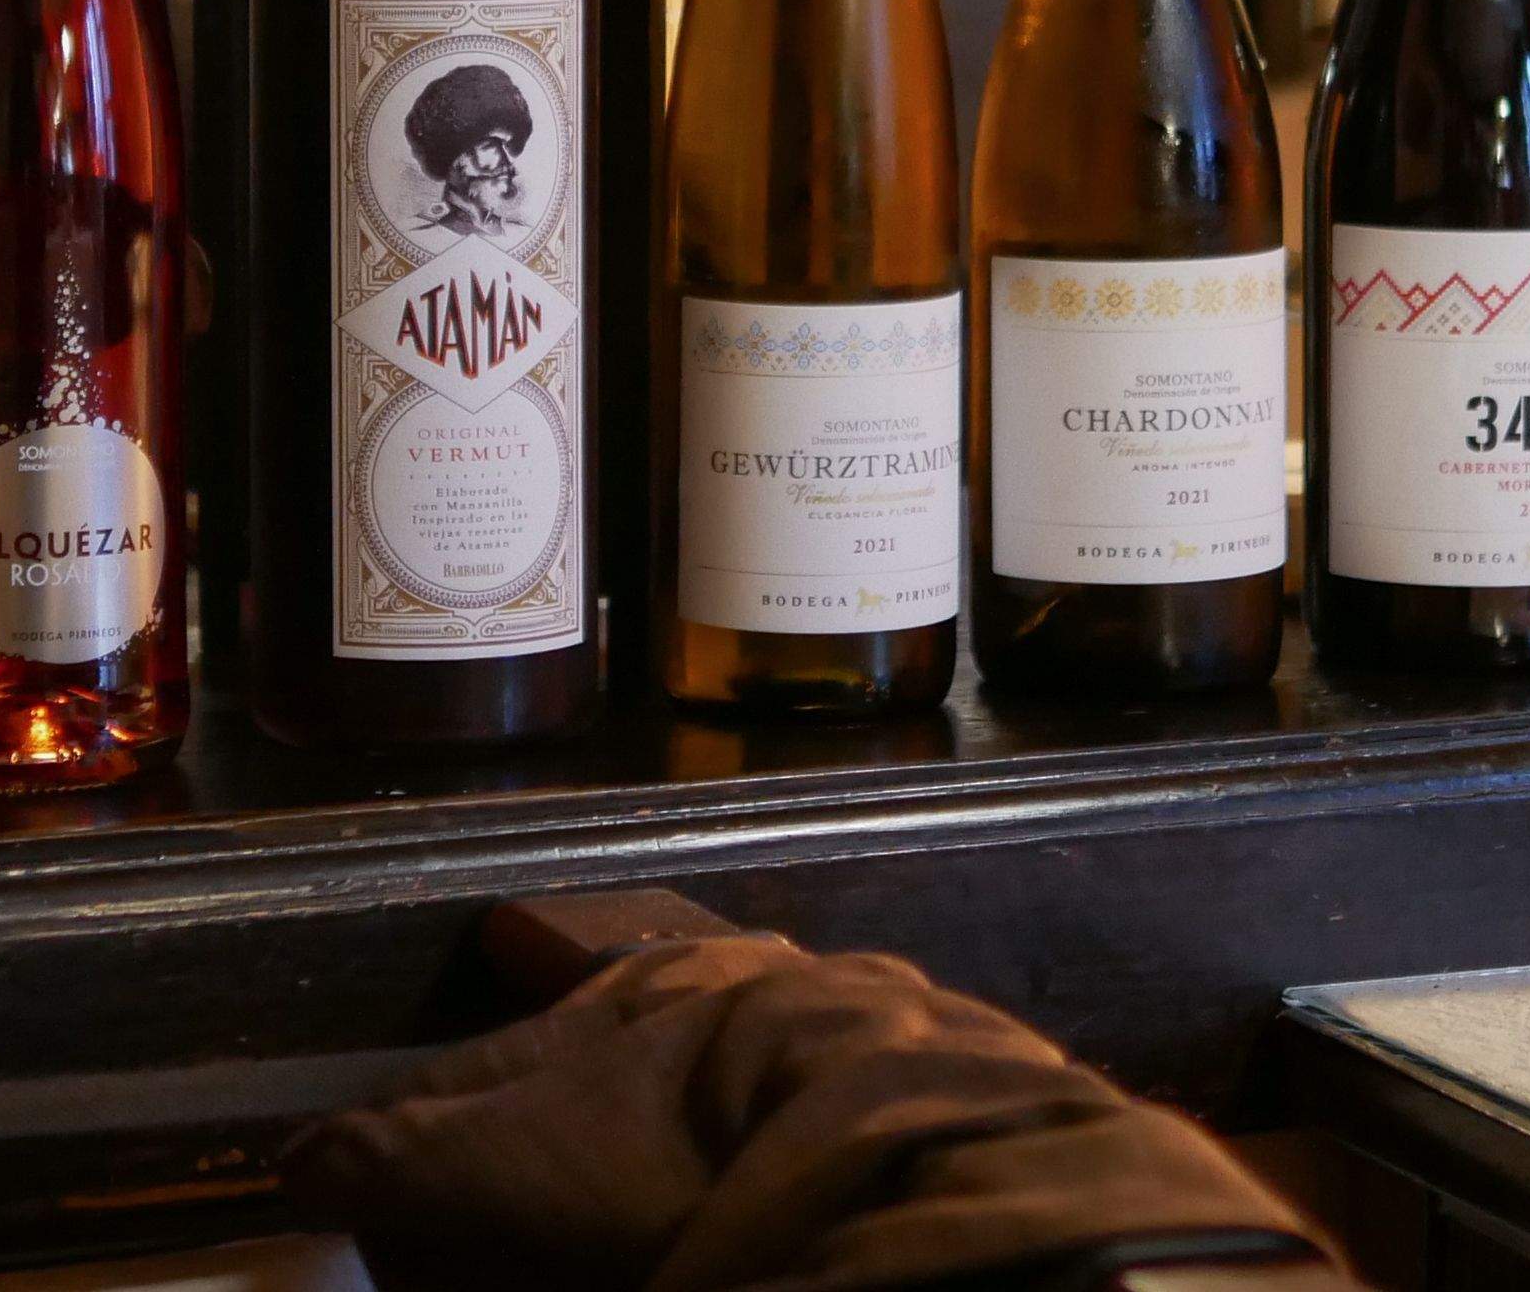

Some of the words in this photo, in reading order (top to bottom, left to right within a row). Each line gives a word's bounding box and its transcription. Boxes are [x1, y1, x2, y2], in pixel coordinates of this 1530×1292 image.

[1134, 370, 1234, 388] SOMONTANO
[1062, 396, 1276, 433] CHARDONNAY
[418, 425, 522, 441] ORIGINAL
[823, 416, 920, 434] SOMONTANO
[408, 443, 531, 463] VERMUT
[1131, 463, 1180, 473] AROMA
[435, 485, 509, 498] Elaborado
[1166, 489, 1210, 506] 2021
[489, 514, 506, 523] en
[807, 509, 885, 520] ELEGANCIA
[433, 541, 451, 551] de
[853, 537, 896, 555] 2021
[1076, 546, 1163, 559] BODEGA
[1210, 534, 1272, 555] PIRINEOS
[1432, 551, 1517, 565] BODEGA
[761, 594, 849, 608] BODEGA
[895, 581, 952, 605] PIRINEOS
[12, 630, 64, 643] BODEGA
[69, 626, 122, 641] PIRINEOS
